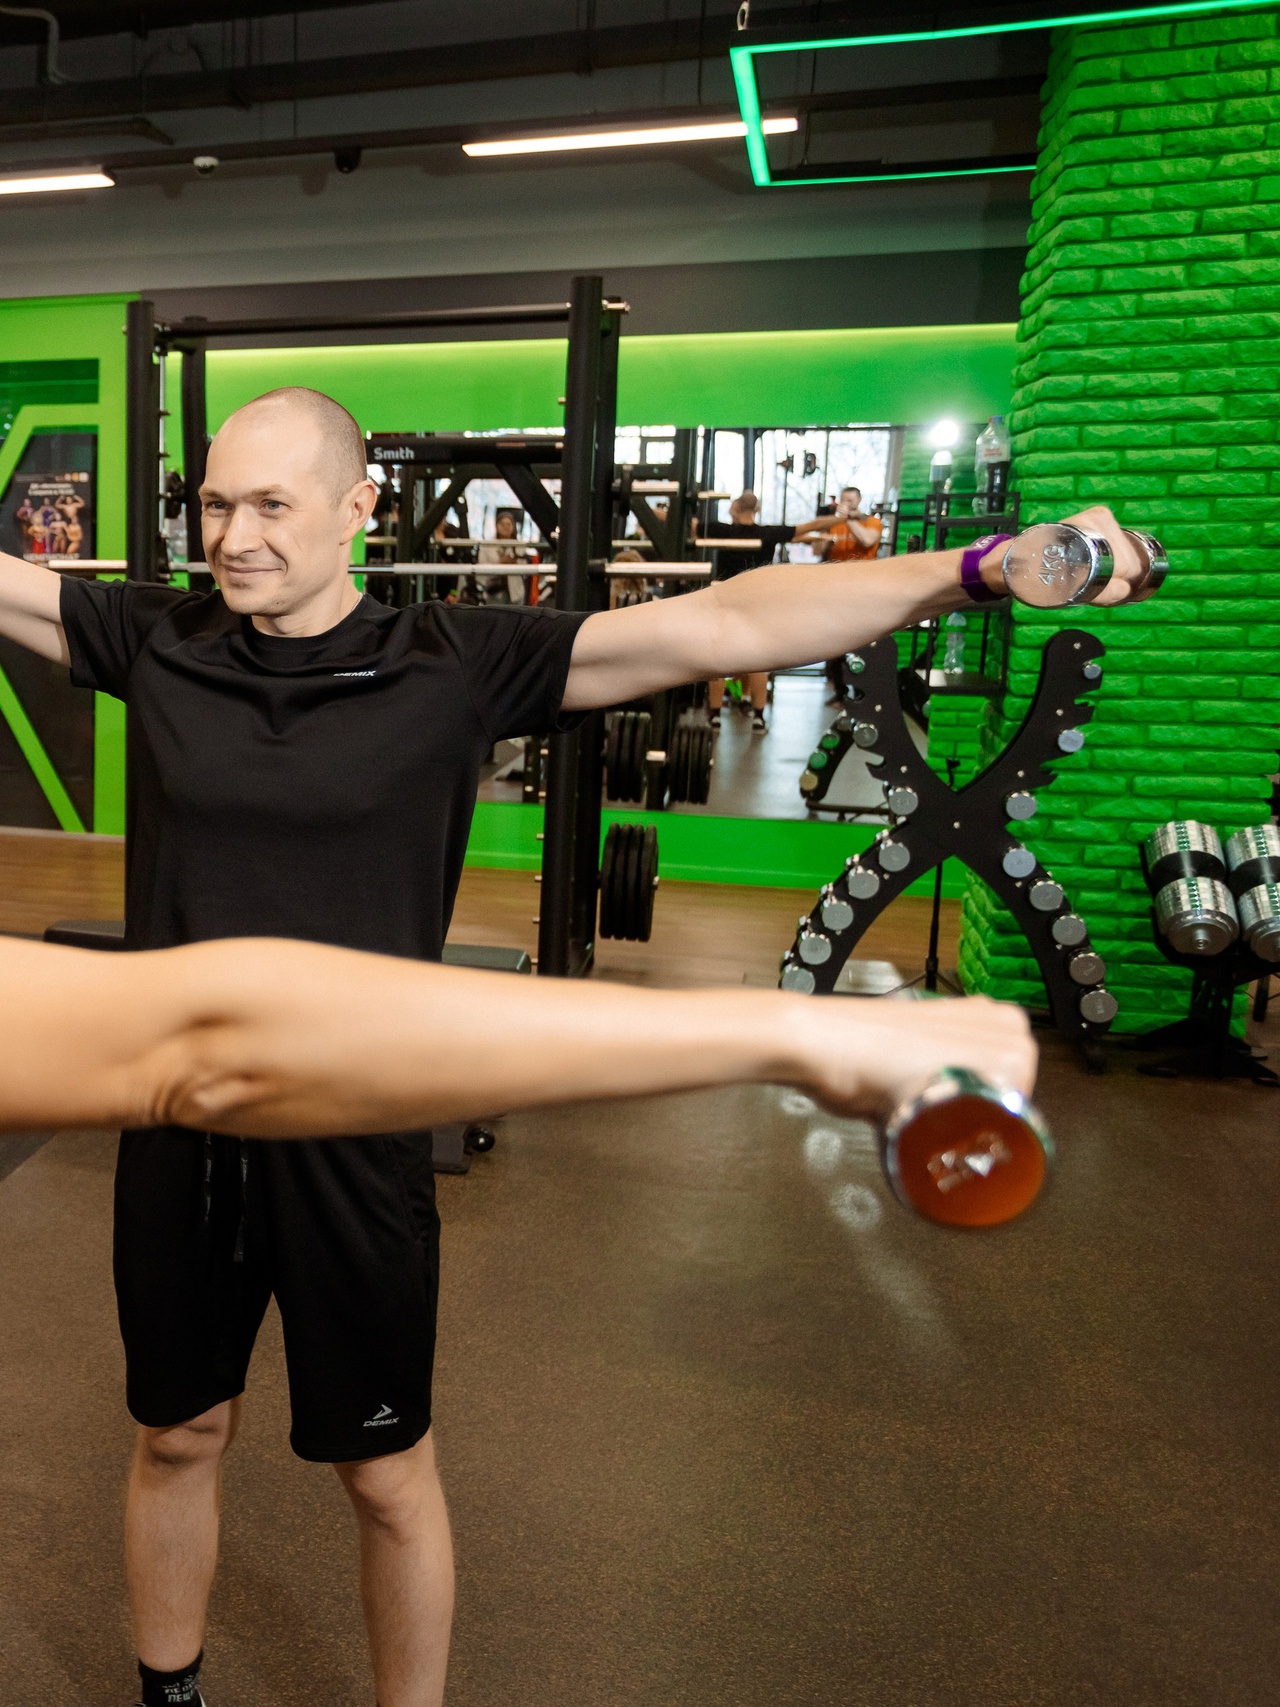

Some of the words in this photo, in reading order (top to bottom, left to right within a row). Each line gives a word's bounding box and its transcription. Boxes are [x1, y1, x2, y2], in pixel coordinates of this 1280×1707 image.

[373, 446, 415, 460] Smith
[1037, 543, 1066, 586] 4KG
[363, 1417, 399, 1427] DEMIX
